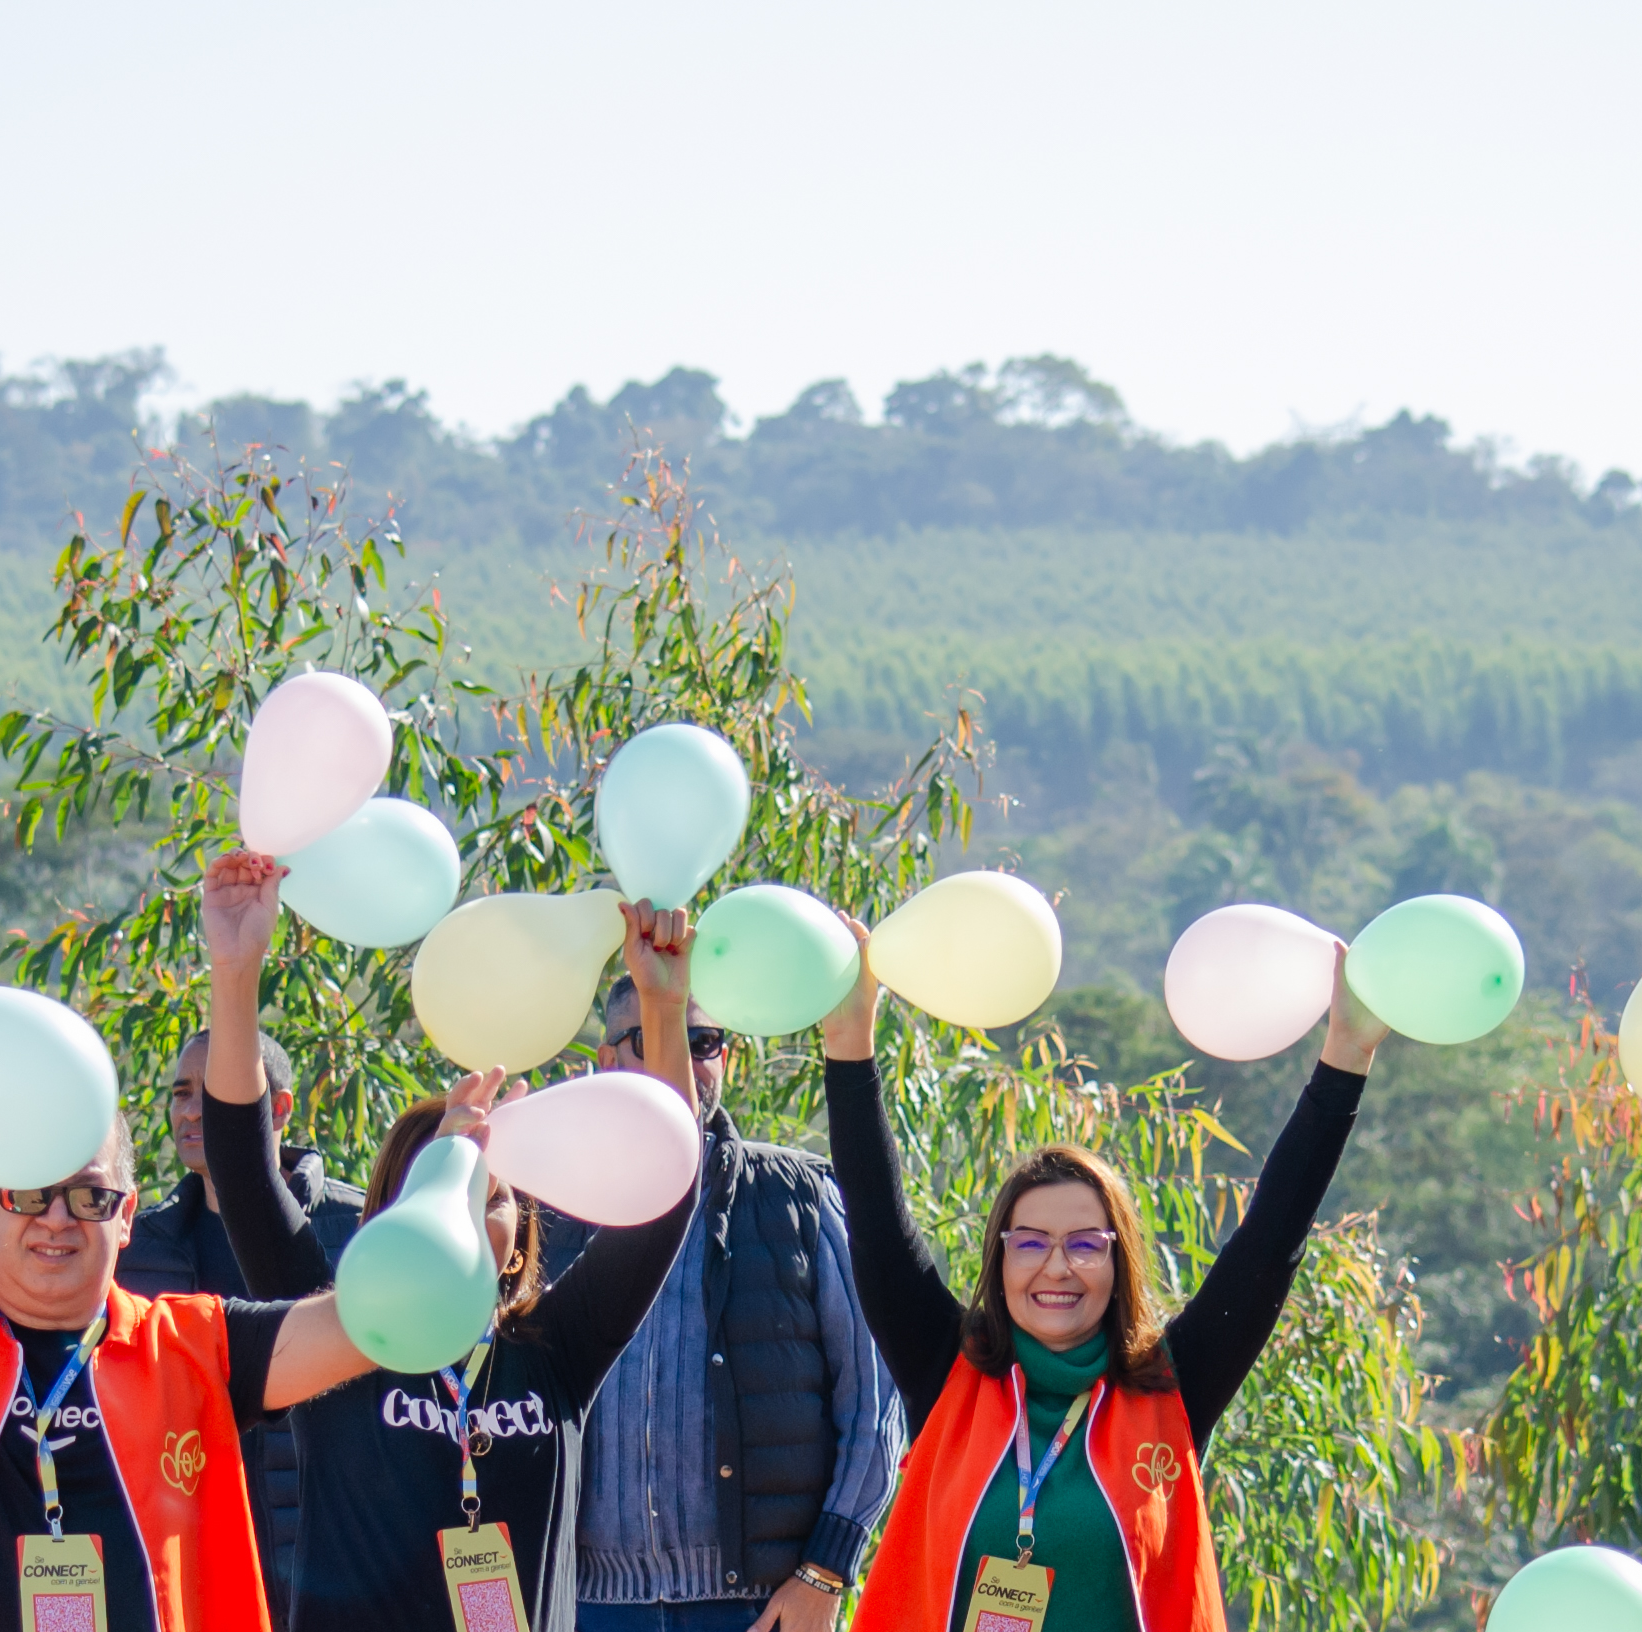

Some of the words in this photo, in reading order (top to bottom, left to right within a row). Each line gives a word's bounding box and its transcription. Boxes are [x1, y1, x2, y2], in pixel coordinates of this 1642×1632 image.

[446, 1551, 499, 1569] CONNECT
[24, 1564, 88, 1577] CONNECT
[978, 1583, 1036, 1603] CONNECT
